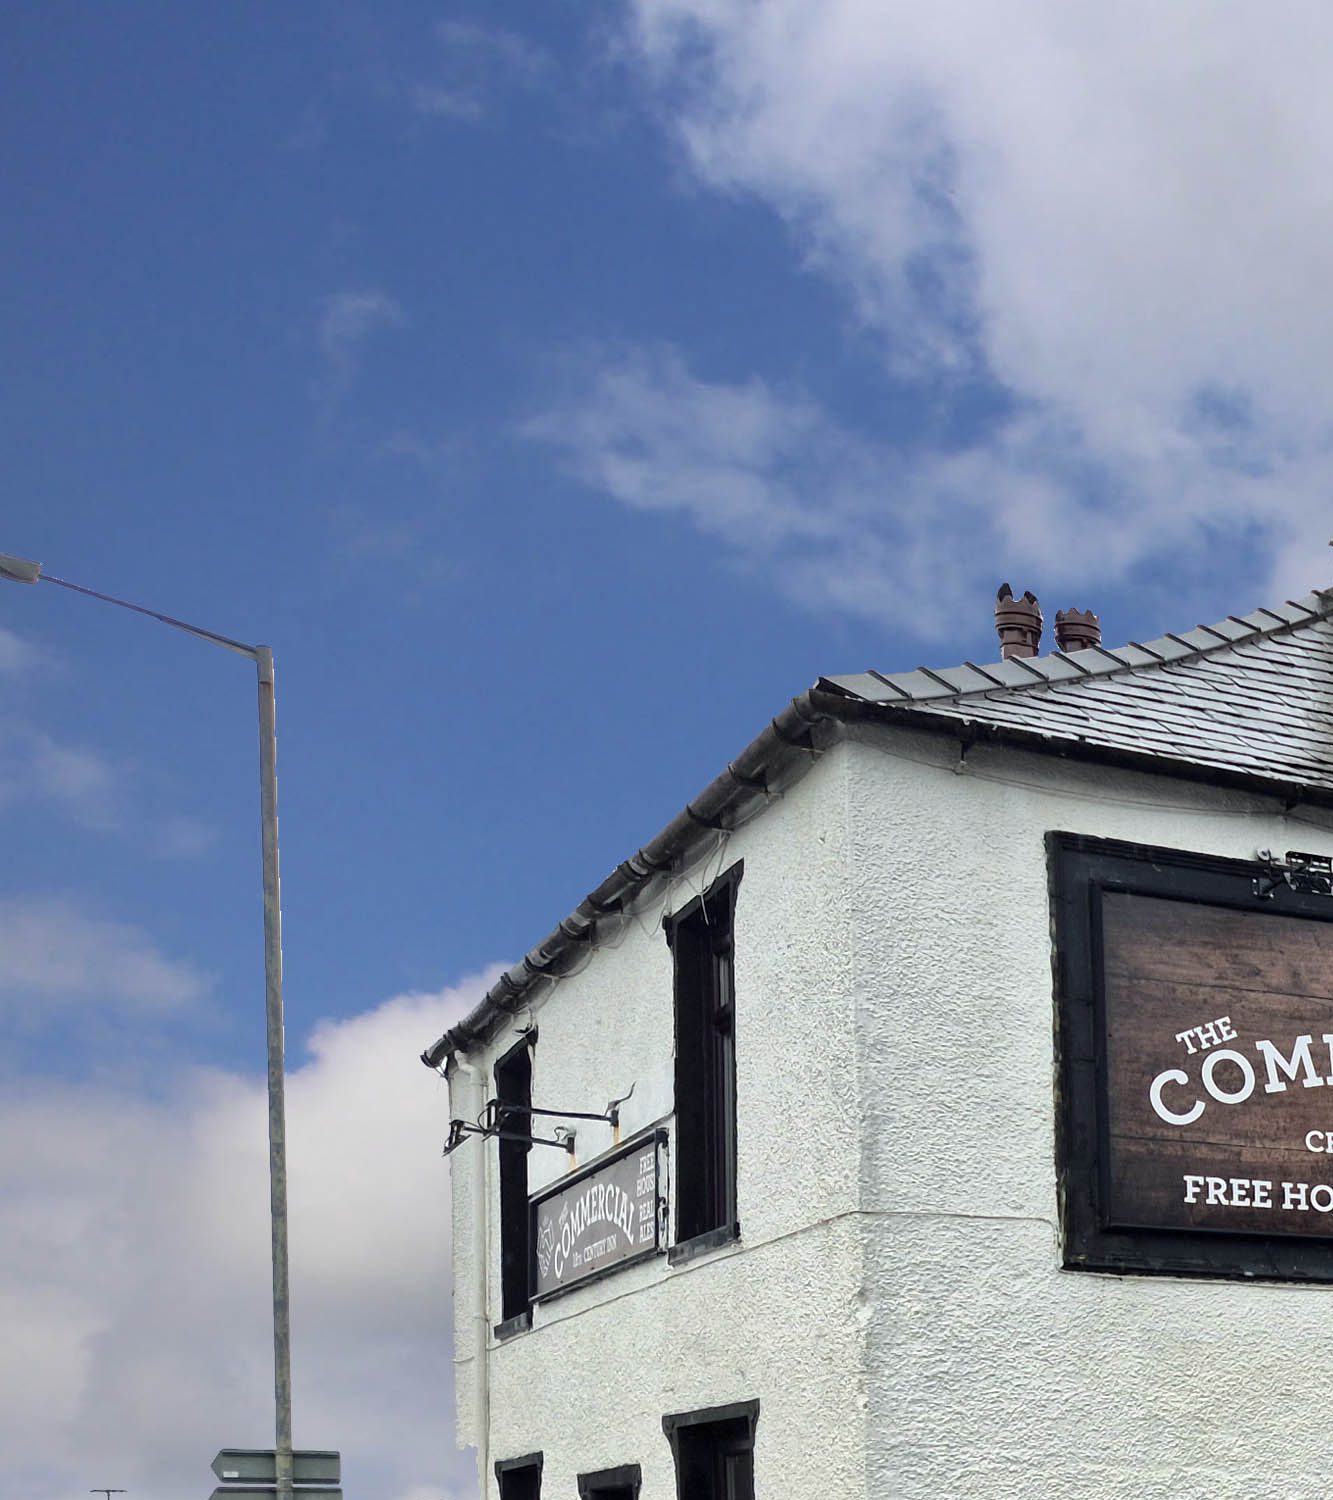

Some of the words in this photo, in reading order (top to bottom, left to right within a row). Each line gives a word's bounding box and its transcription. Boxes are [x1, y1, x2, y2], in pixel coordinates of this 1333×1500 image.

[1175, 1016, 1238, 1055] THE
[1184, 1175, 1273, 1209] FREE
[554, 1183, 635, 1279] COMMERCIAL
